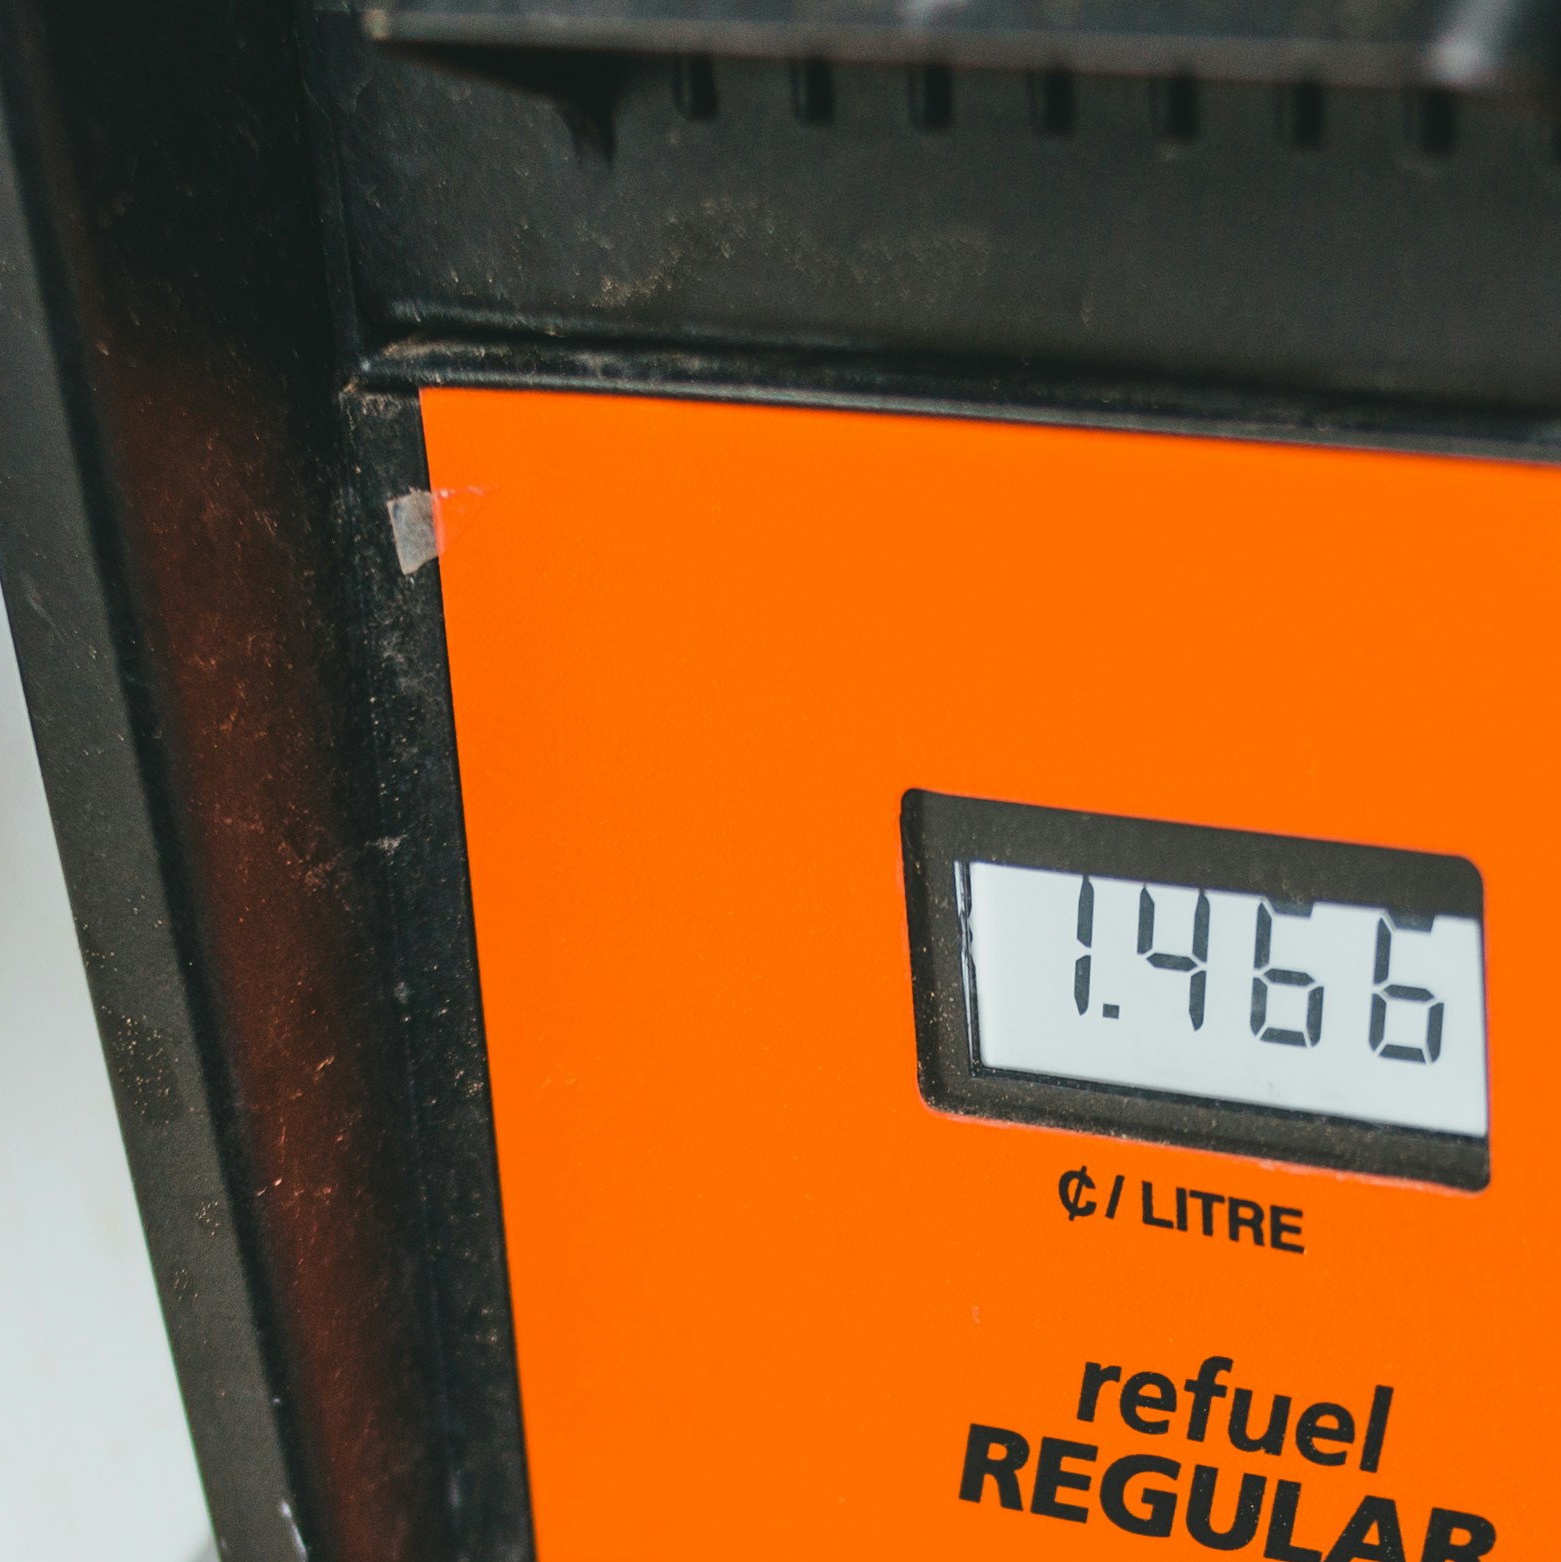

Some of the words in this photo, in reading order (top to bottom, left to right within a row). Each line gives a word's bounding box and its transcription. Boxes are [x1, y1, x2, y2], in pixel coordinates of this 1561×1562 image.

[1073, 874, 1445, 1064] 1.466
[1141, 1180, 1306, 1254] LITRE
[1077, 1356, 1394, 1473] refuel
